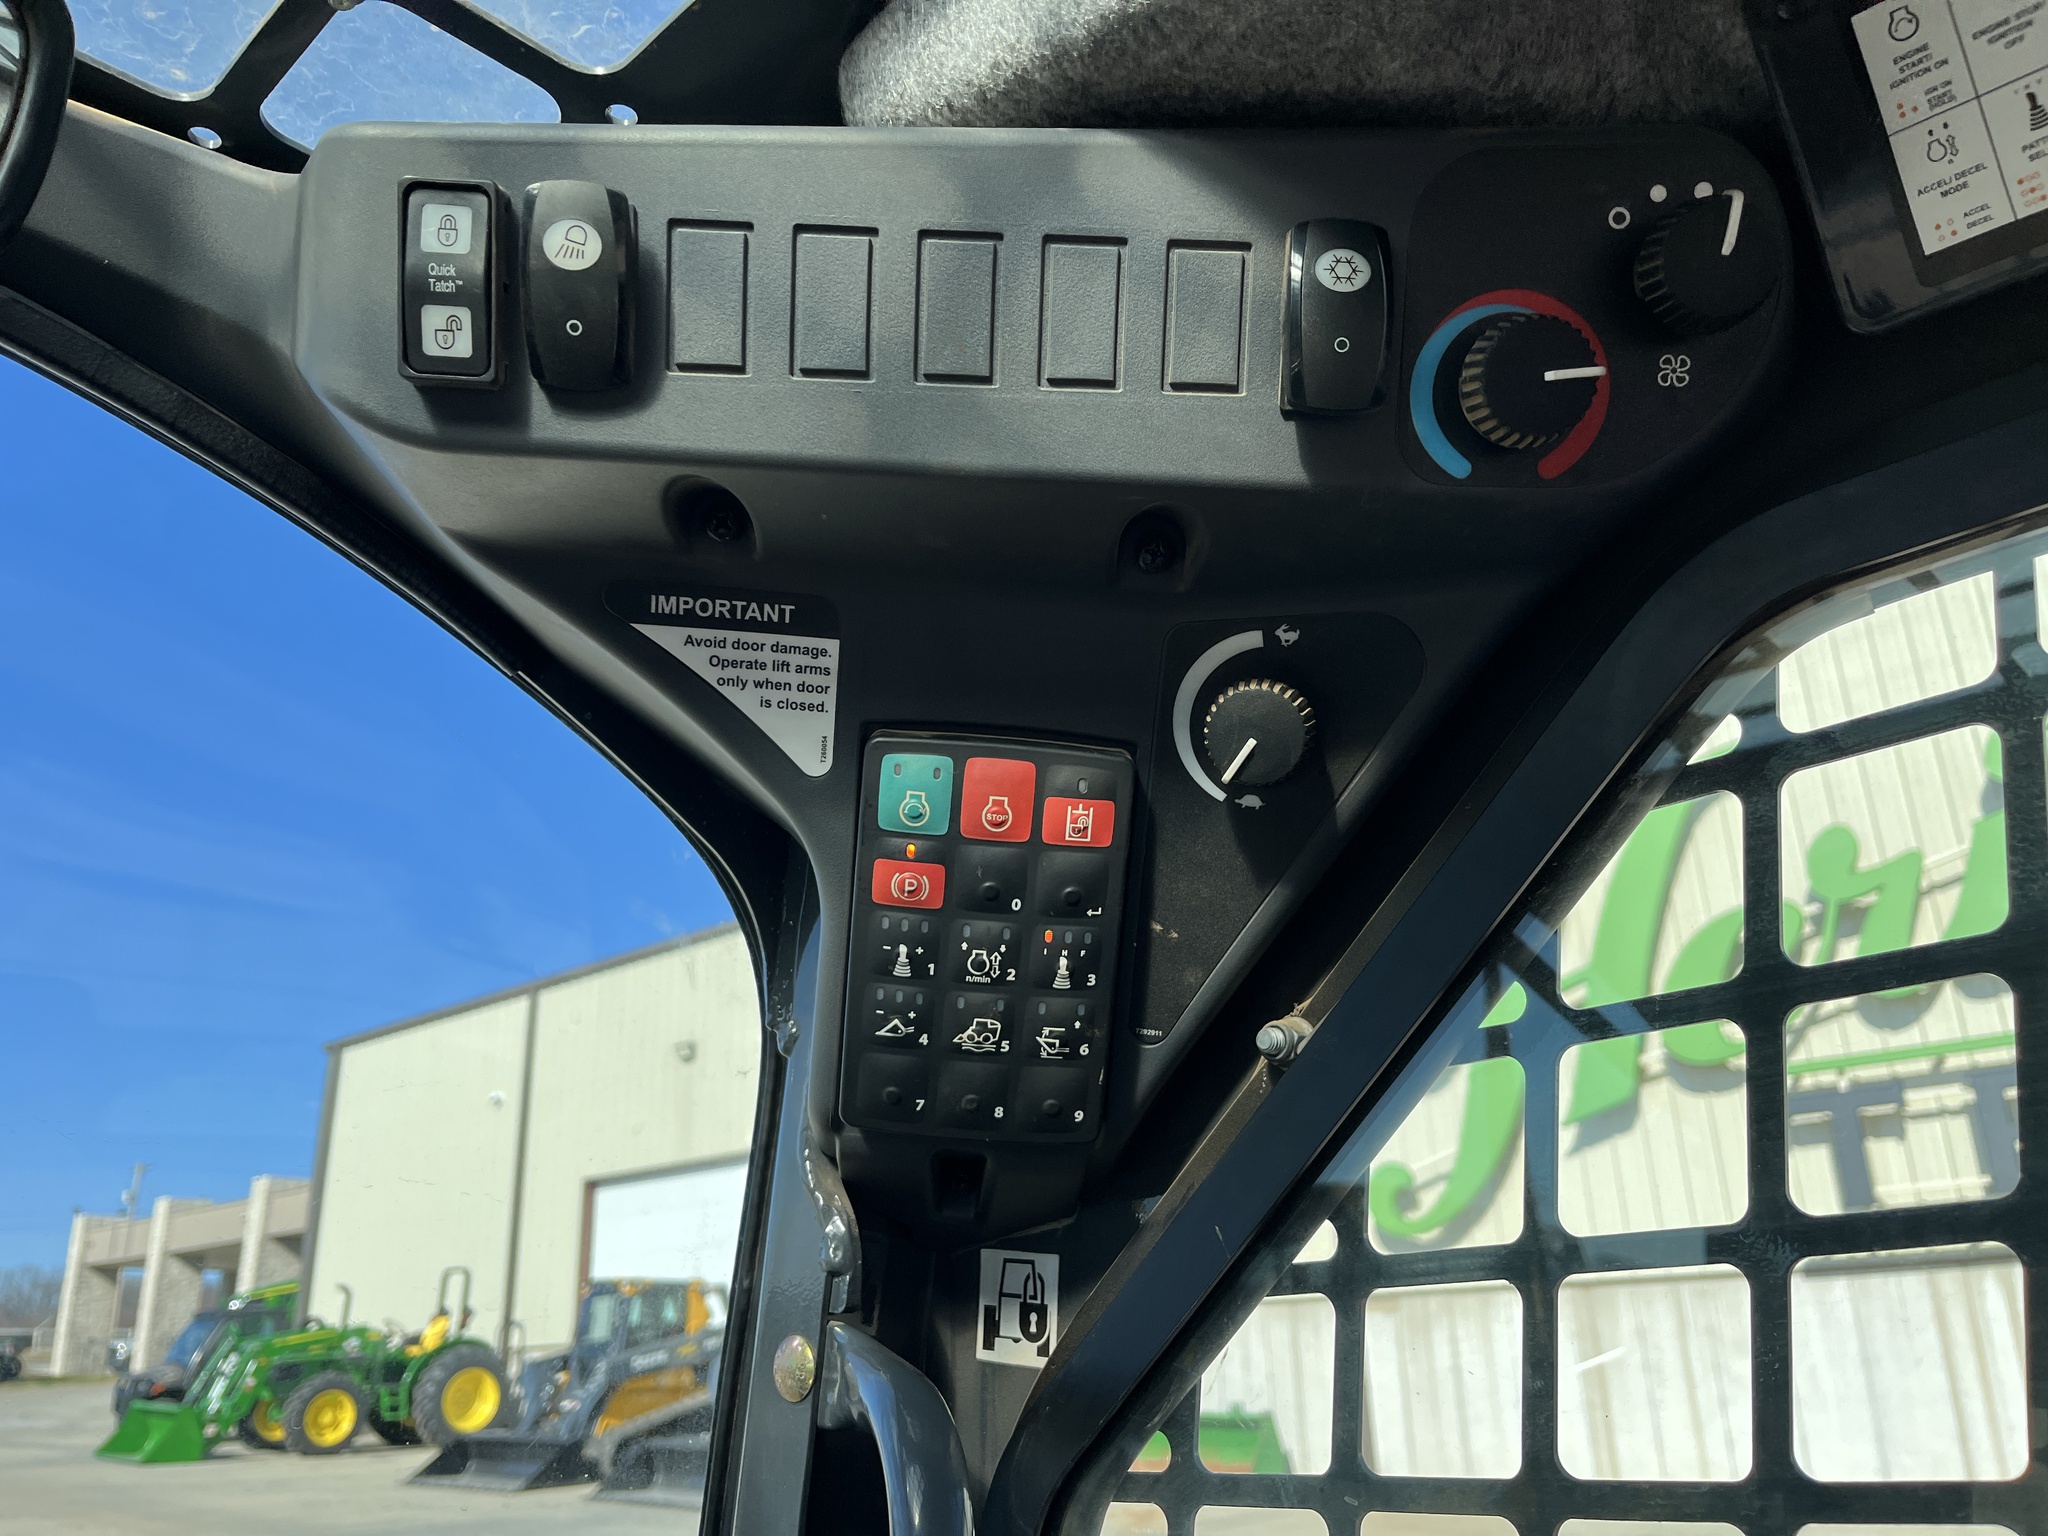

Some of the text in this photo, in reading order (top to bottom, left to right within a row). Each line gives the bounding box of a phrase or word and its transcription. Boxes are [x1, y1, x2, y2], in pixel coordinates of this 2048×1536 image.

[1893, 41, 1929, 65] ENGINE
[1889, 57, 1949, 90] IGNITION ON
[1917, 162, 1988, 197] ACCEL/ DECEL
[1940, 181, 1969, 198] MODE
[1963, 203, 1991, 218] ACCEL
[1966, 214, 1995, 230] DECEL
[428, 262, 456, 277] Quick
[650, 594, 795, 623] IMPORTANT
[684, 634, 832, 659] Avoid door damage.
[709, 655, 831, 676] Operate lift arms
[716, 675, 830, 695] only when door
[759, 696, 829, 713] is closed.
[820, 735, 828, 763] T260054
[986, 813, 1009, 821] STOP
[904, 879, 918, 894] P
[1011, 899, 1021, 911] 0
[1061, 949, 1068, 957] H
[927, 963, 935, 976] 1
[1006, 968, 1016, 981] 2
[965, 974, 991, 984] n/min
[1086, 974, 1096, 986] 3
[919, 1033, 929, 1046] 4
[1000, 1040, 1010, 1052] 5
[1079, 1044, 1090, 1056] 6
[915, 1100, 926, 1111] 7
[993, 1106, 1004, 1118] 8
[1074, 1110, 1084, 1122] 9
